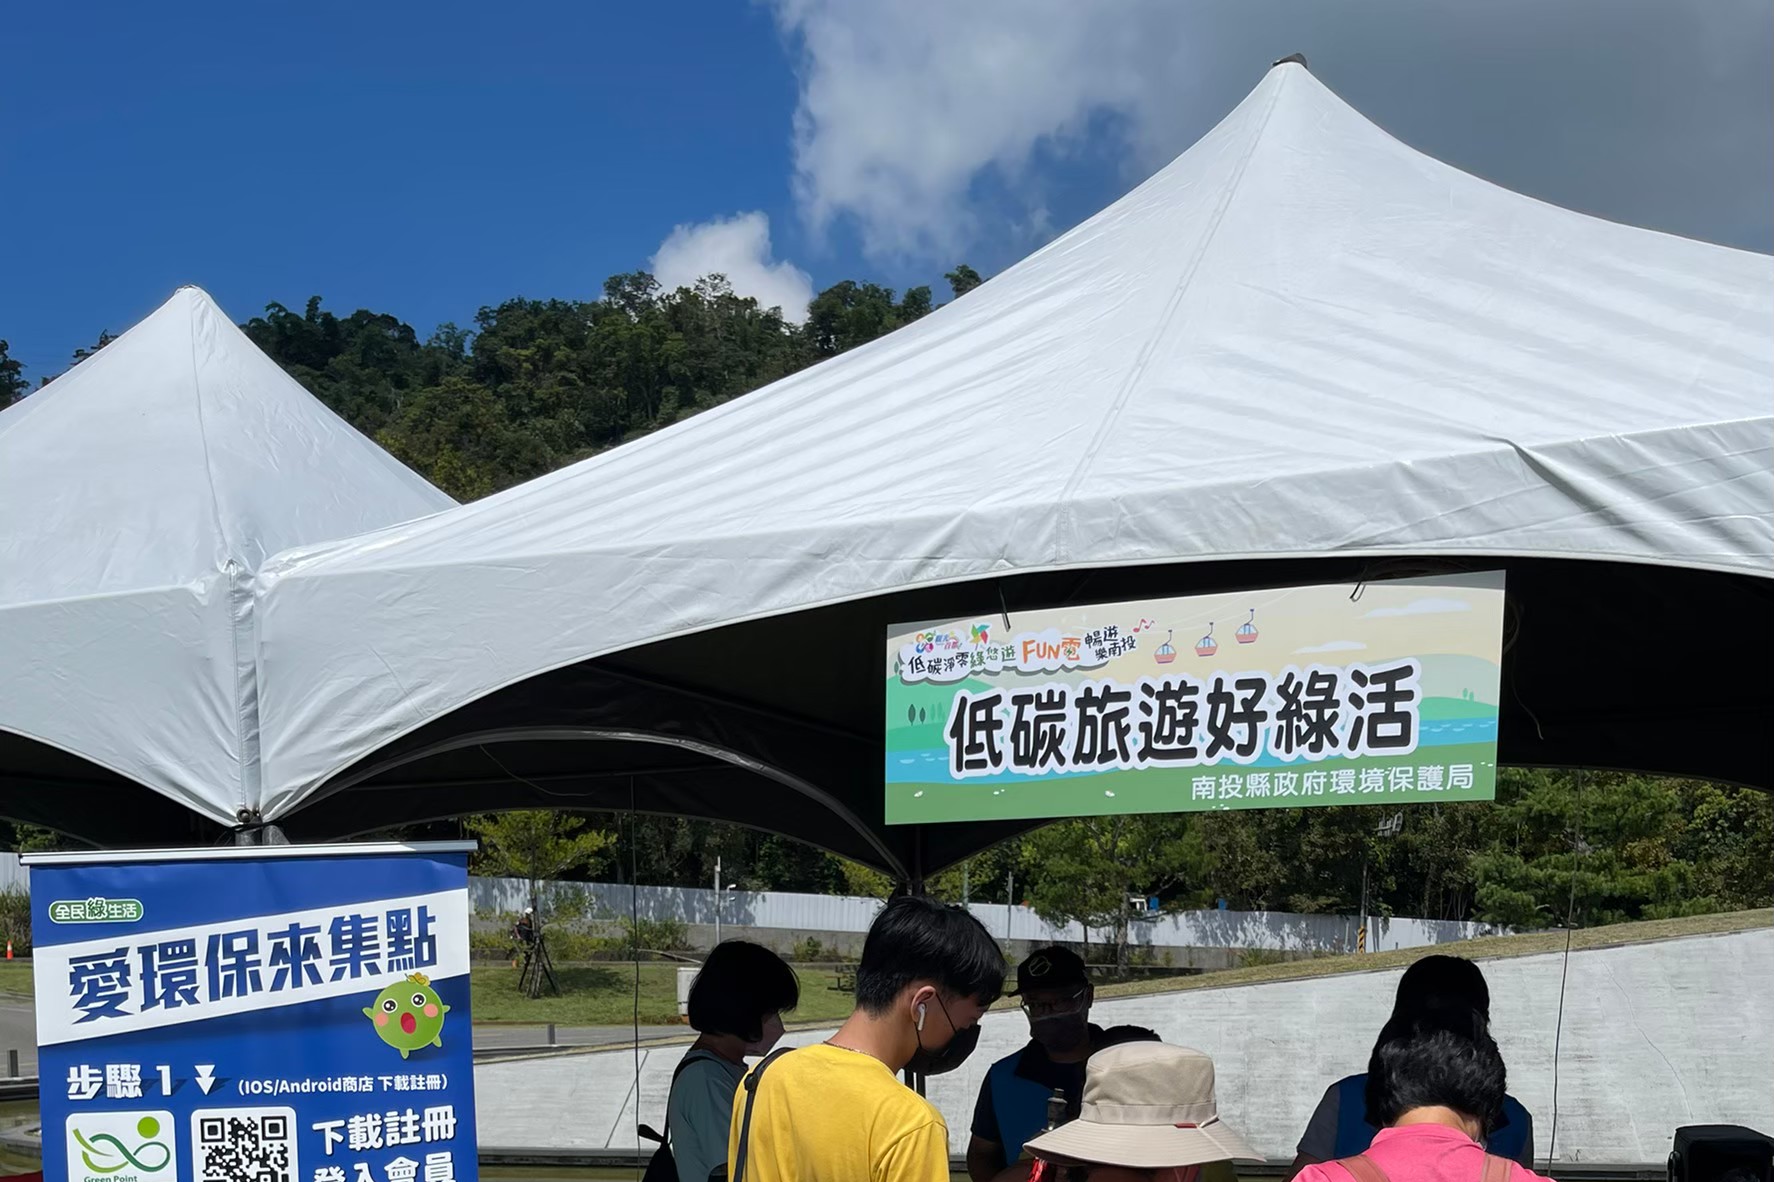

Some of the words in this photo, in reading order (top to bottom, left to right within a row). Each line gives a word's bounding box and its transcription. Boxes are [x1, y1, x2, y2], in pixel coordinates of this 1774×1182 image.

[1084, 625, 1119, 649] 暢遊
[950, 664, 1416, 771] 低碳旅遊好綠活
[1191, 764, 1474, 800] 南投縣政府環境保護局
[54, 896, 138, 920] 全民綠生活
[69, 905, 437, 1025] 愛環保來集點
[67, 1064, 142, 1100] 步驟
[312, 1105, 457, 1155] 下載註冊
[113, 1174, 138, 1182] Point
